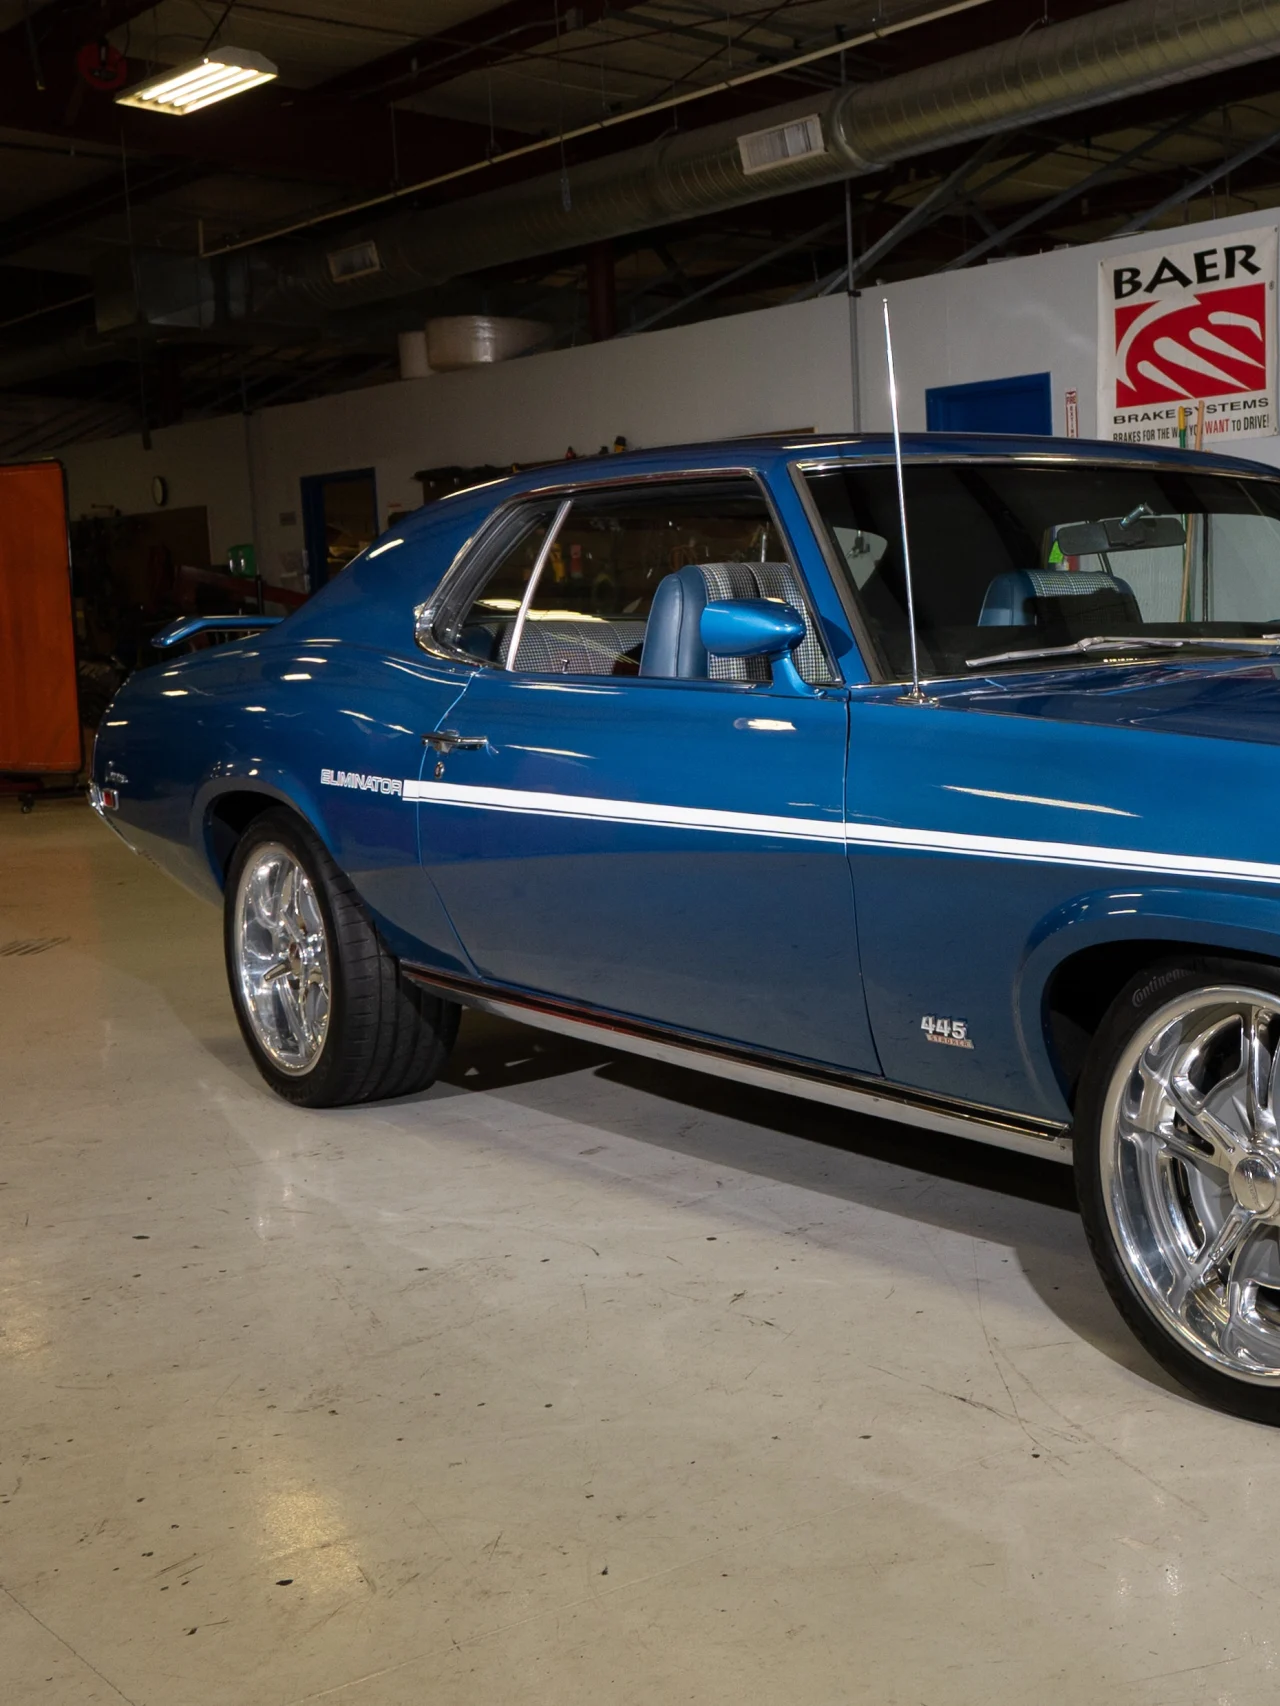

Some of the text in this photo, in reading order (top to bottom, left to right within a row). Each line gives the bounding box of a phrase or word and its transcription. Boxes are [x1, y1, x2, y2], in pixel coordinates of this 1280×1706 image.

[1113, 244, 1262, 300] BAER
[1113, 409, 1176, 425] BRAKE
[1113, 430, 1142, 443] BRAKES
[1142, 428, 1156, 442] FOR
[1157, 427, 1170, 440] THE
[1204, 418, 1230, 435] WANT
[1231, 419, 1242, 432] TO
[1243, 413, 1270, 430] DRIVE!
[320, 768, 403, 796] ELIMINATOR
[921, 1015, 968, 1040] 445
